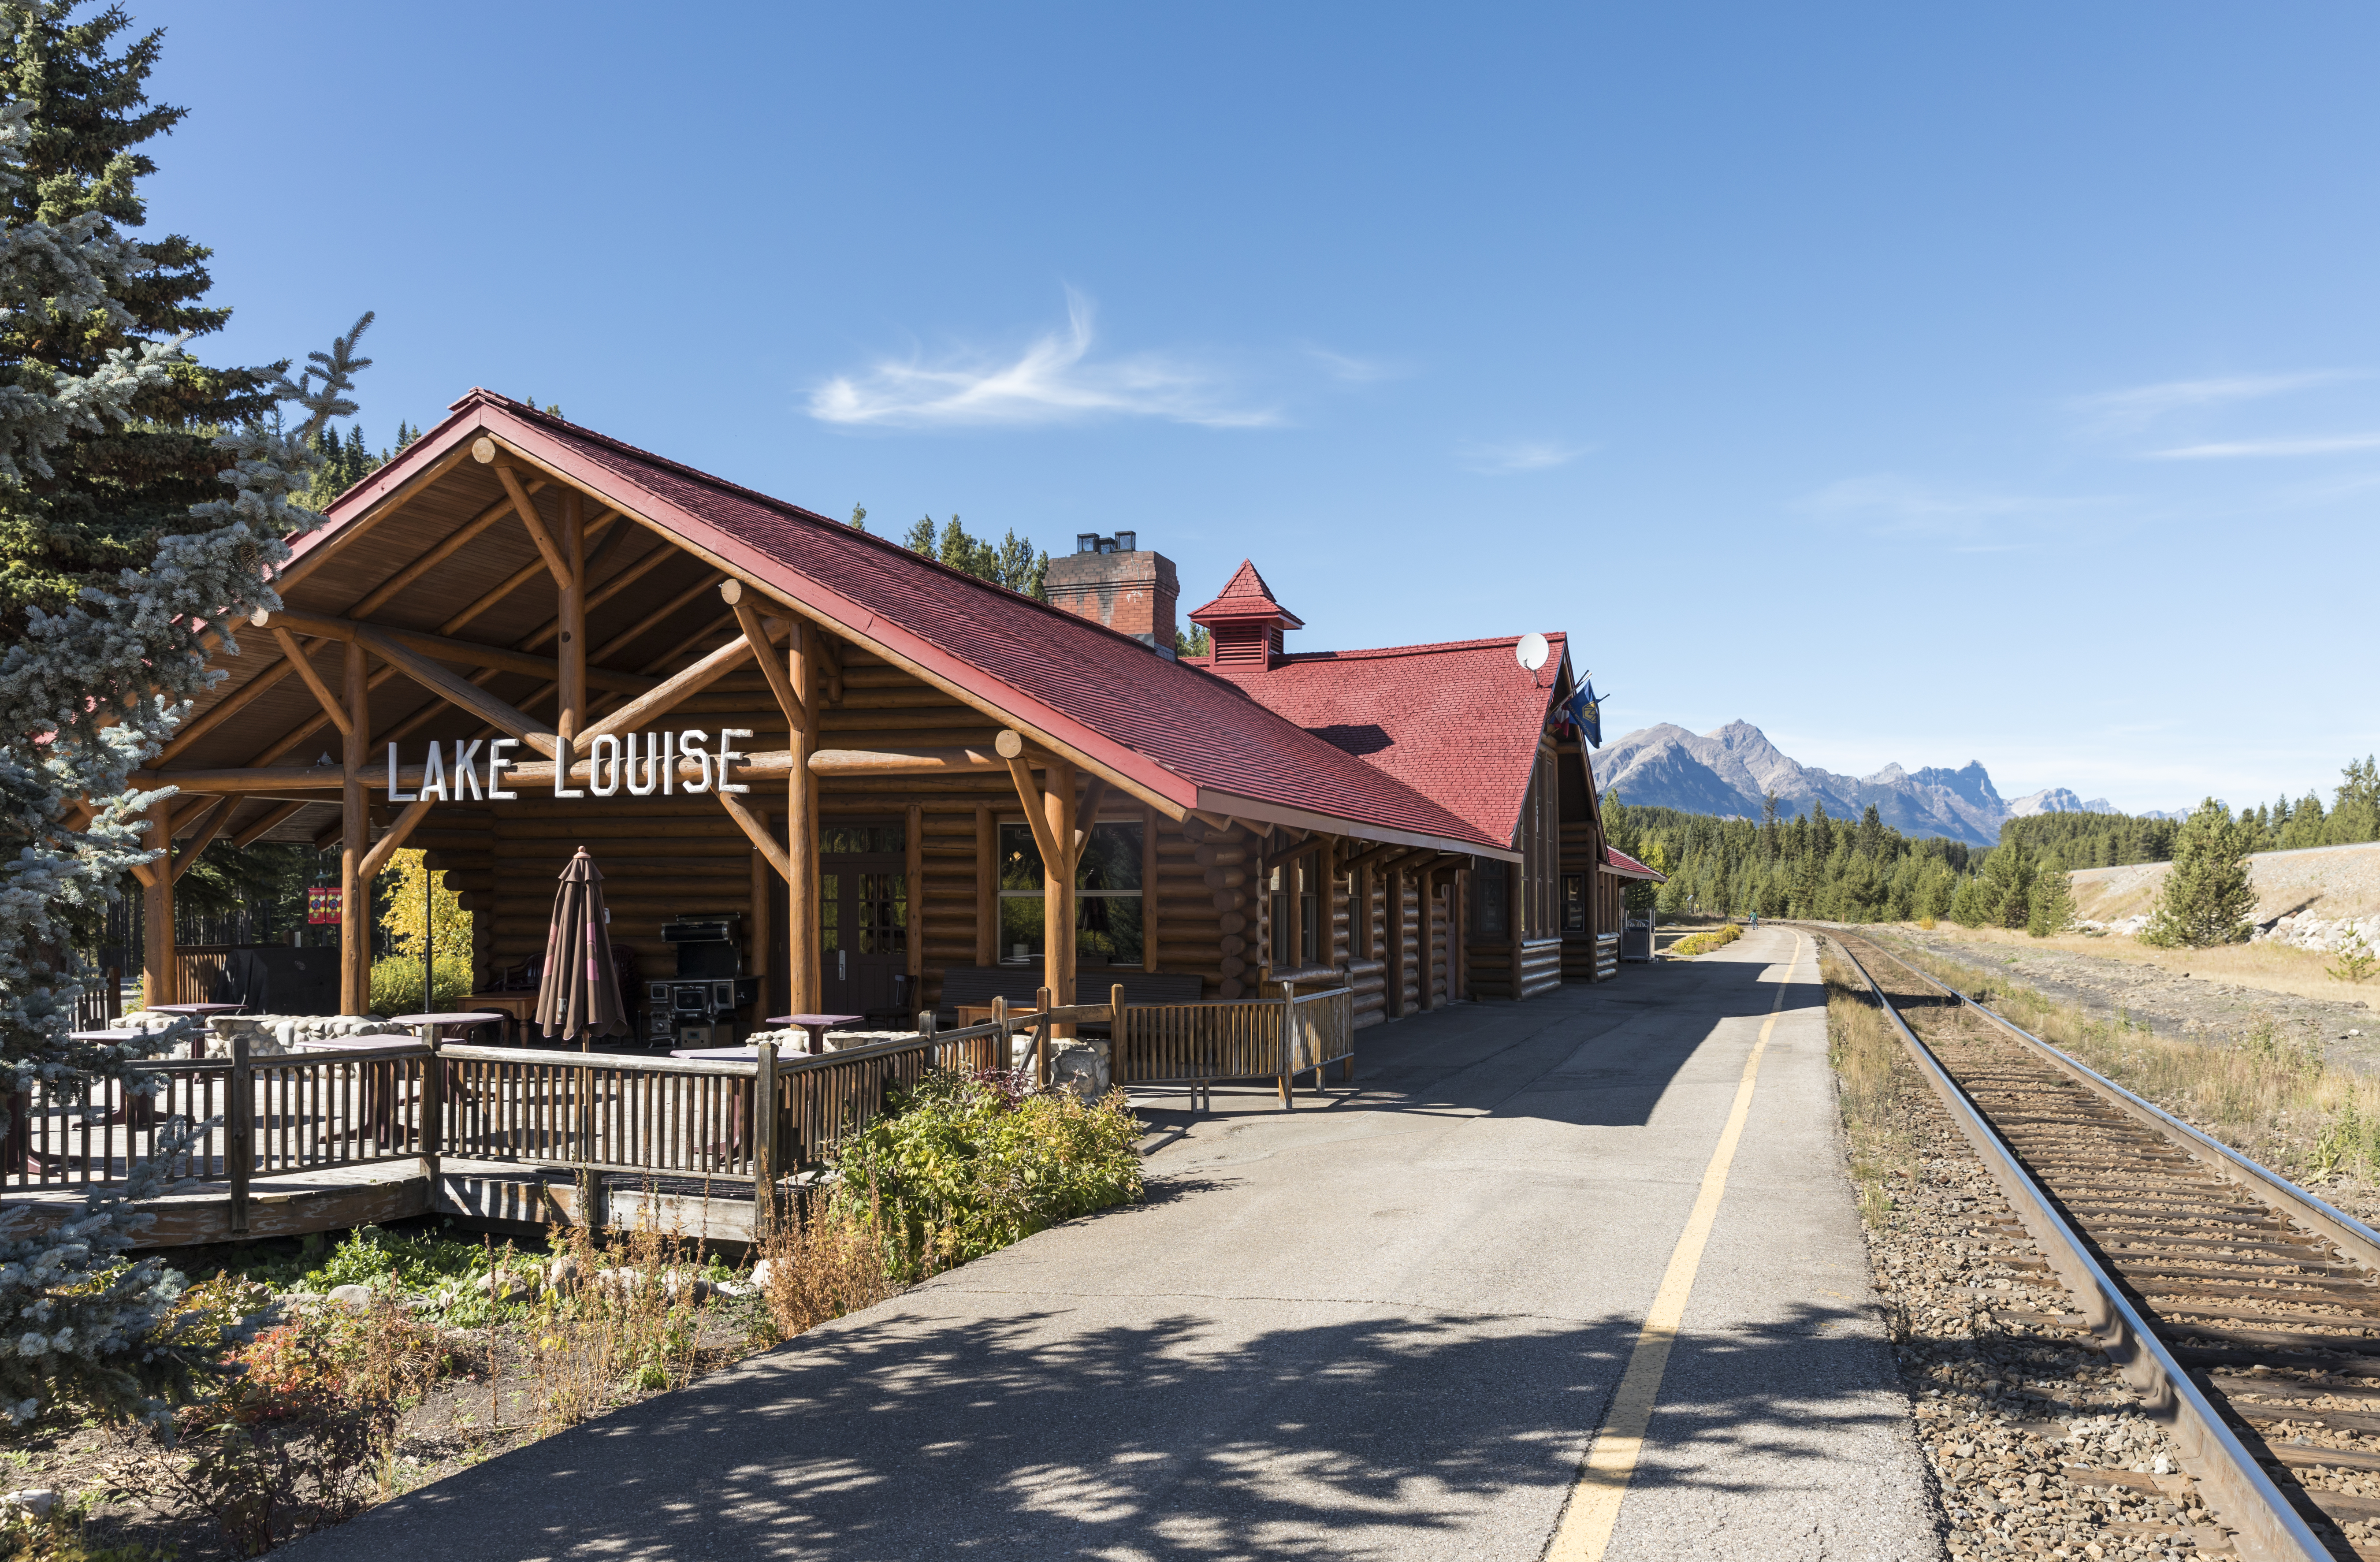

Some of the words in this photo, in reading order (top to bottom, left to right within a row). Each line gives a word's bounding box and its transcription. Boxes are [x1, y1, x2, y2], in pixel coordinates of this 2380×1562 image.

[1575, 713, 1594, 741] MOUNTAINEER
[389, 738, 519, 801] LAKE
[555, 729, 753, 798] LOUISE
